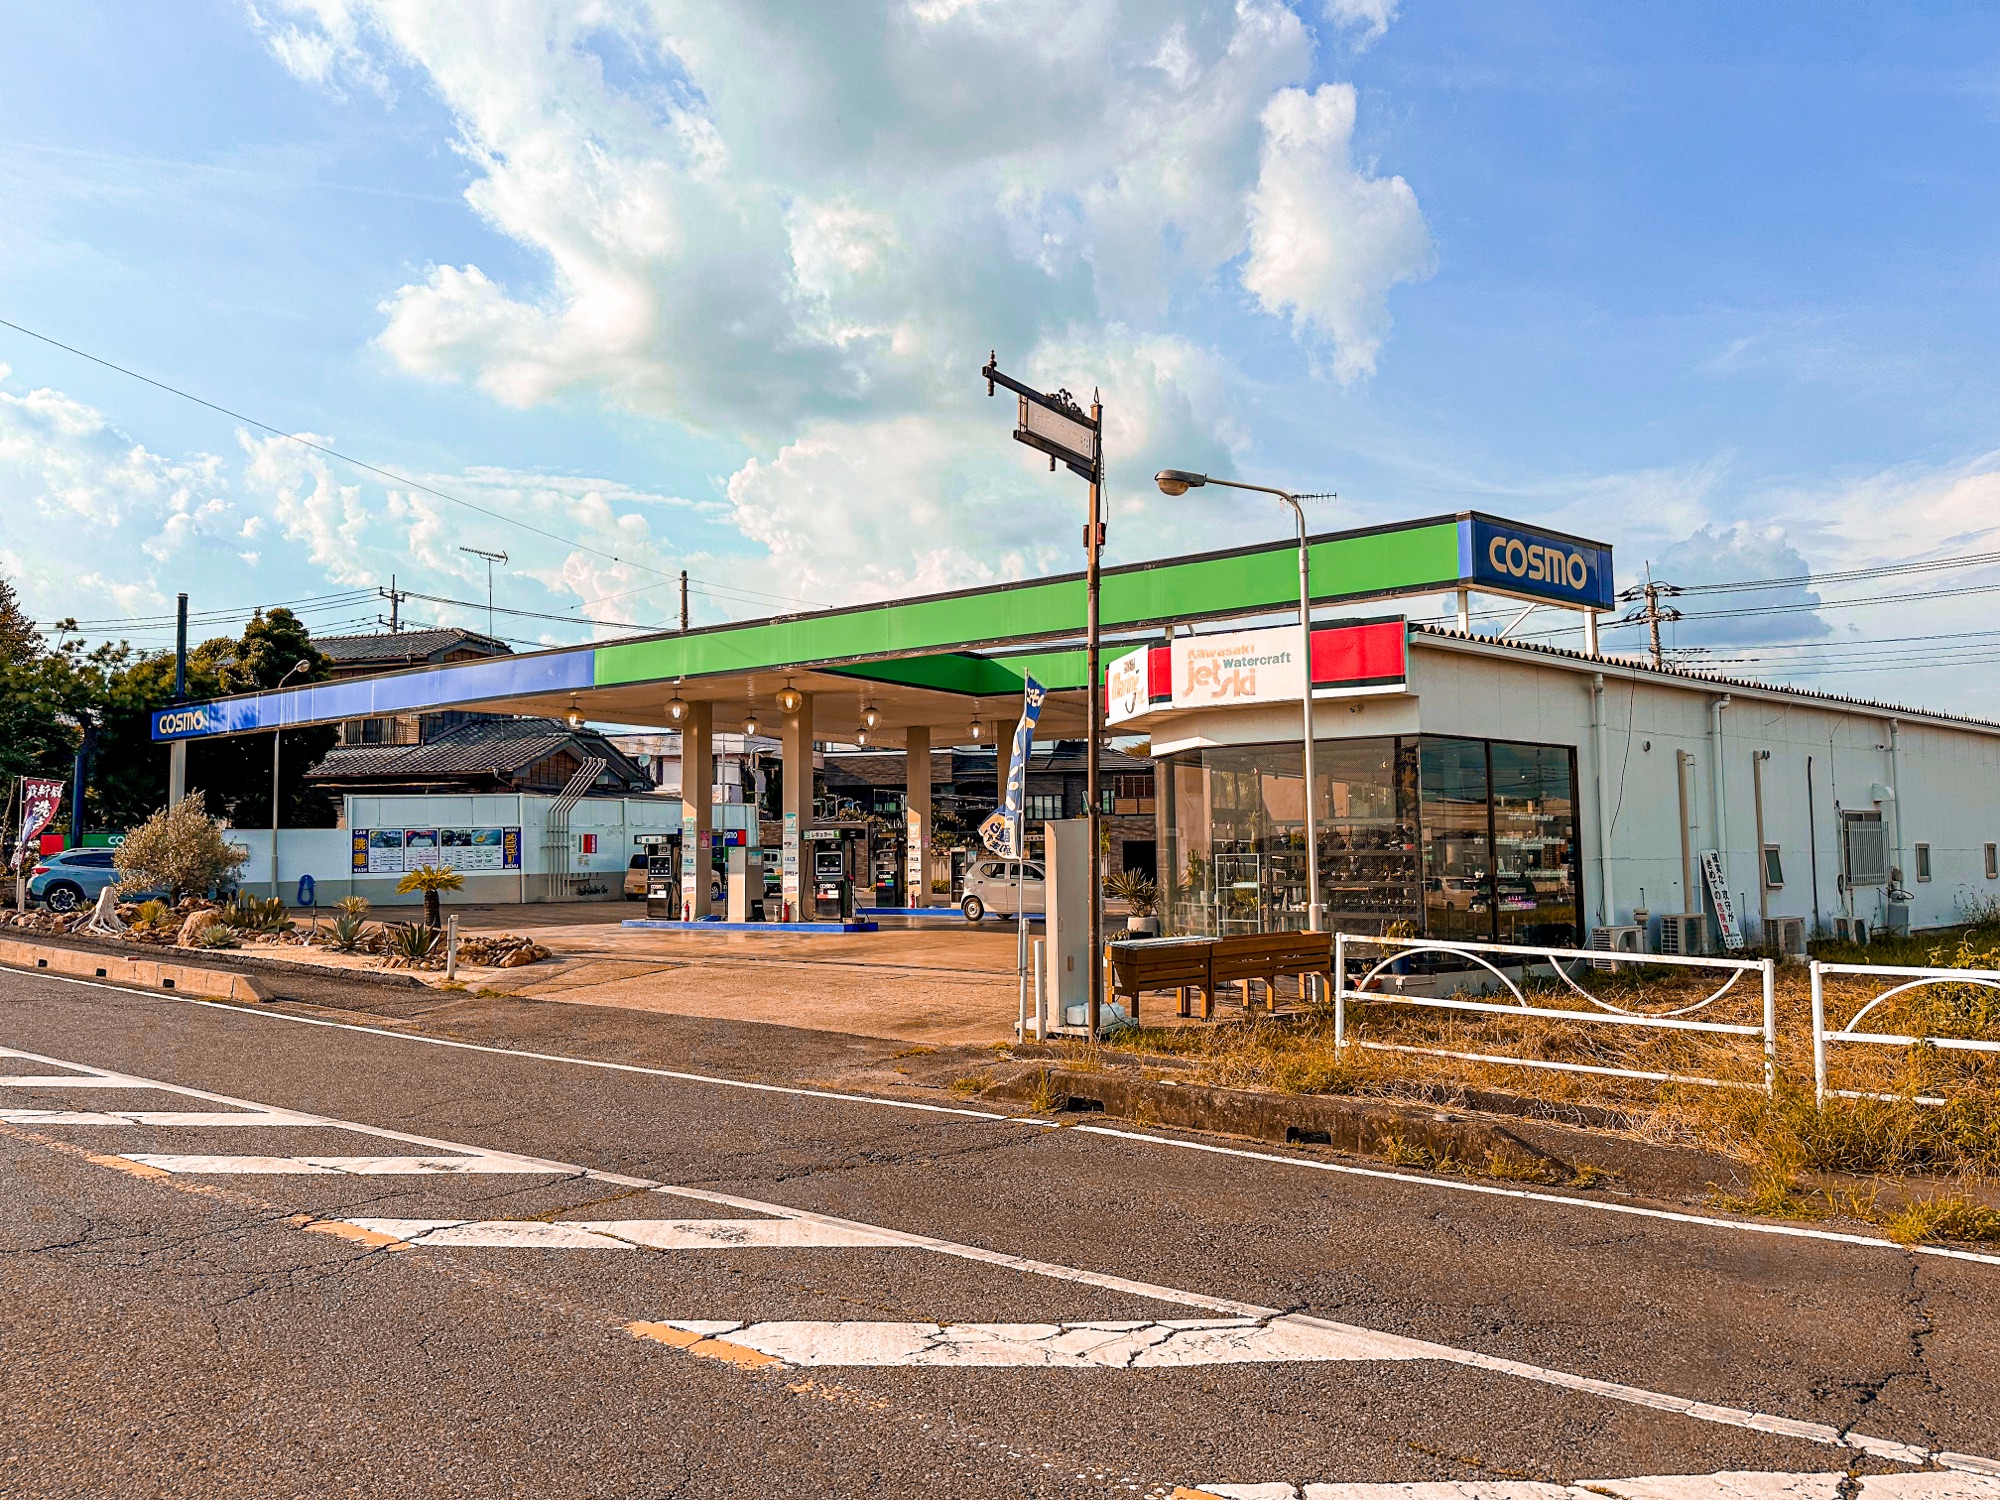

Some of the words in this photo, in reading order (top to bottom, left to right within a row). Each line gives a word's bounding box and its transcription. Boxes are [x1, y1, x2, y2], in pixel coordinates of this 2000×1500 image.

[1489, 536, 1587, 590] COSMO
[1188, 644, 1254, 660] Kawasaki
[1223, 652, 1291, 669] Watercraft
[159, 709, 204, 734] COSMO
